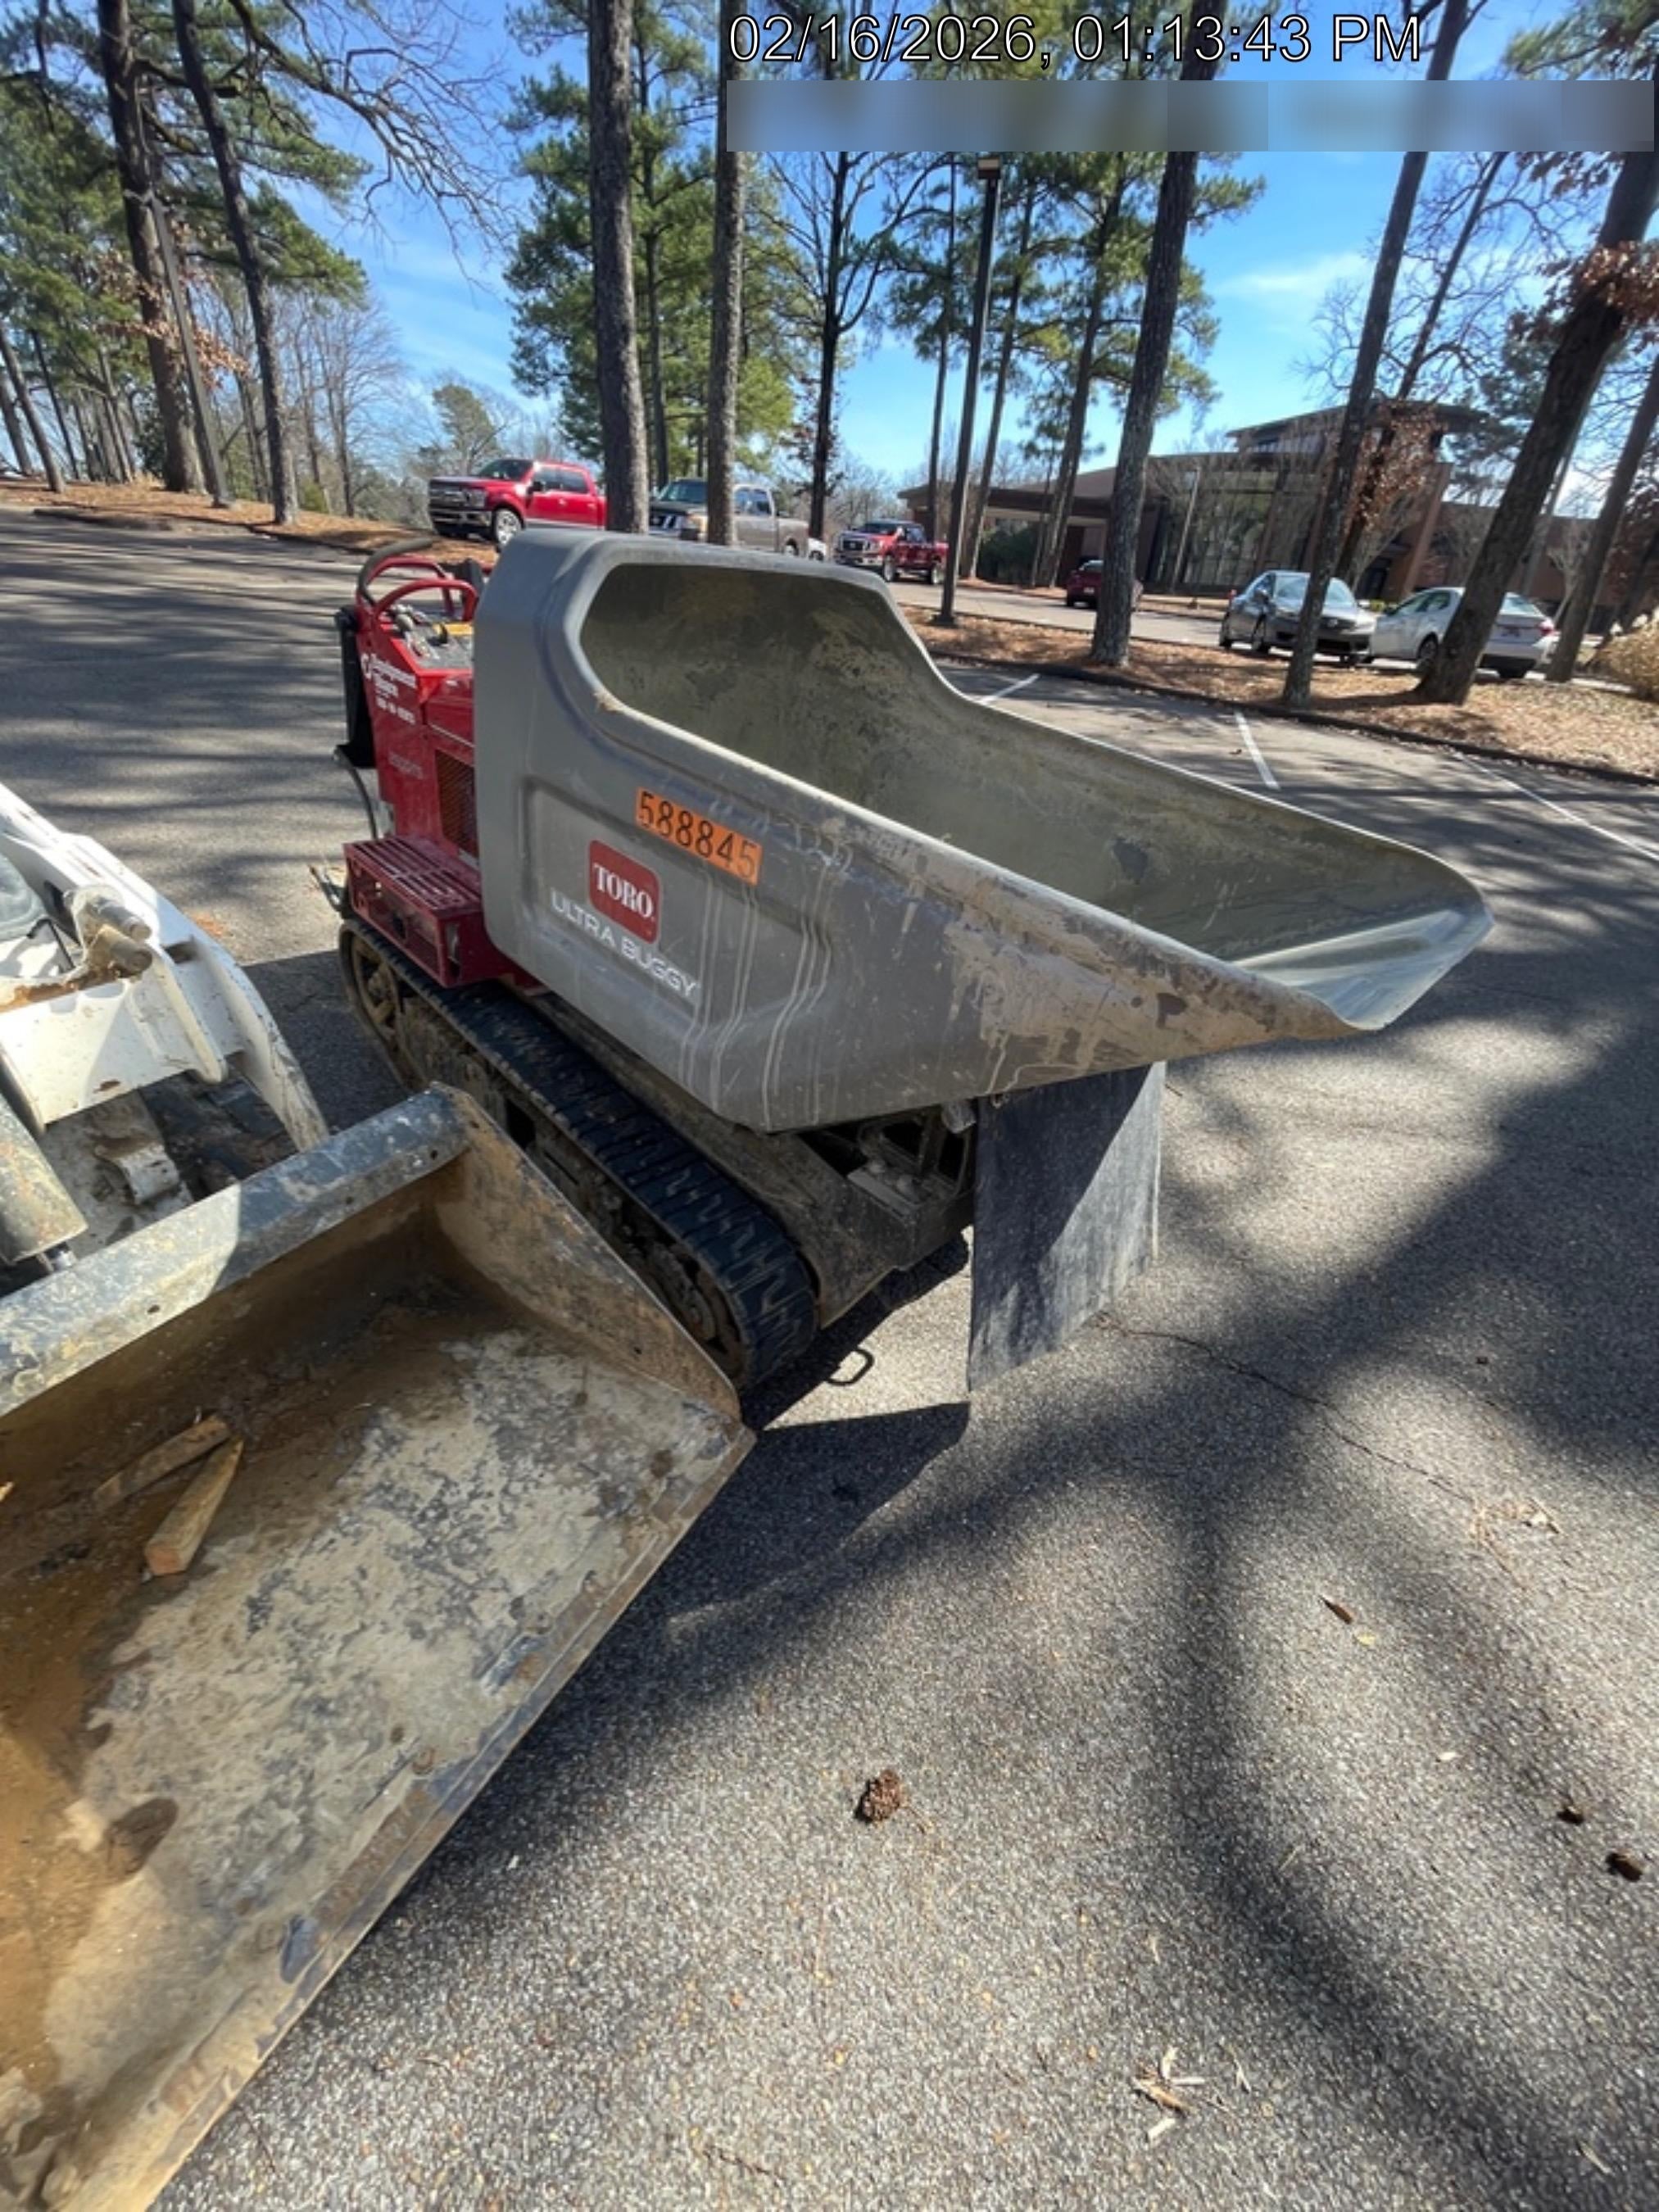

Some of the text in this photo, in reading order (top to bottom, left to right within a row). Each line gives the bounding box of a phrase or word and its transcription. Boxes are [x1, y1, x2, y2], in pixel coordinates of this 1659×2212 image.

[638, 790, 757, 878] 588845
[593, 863, 654, 918] TORO
[551, 889, 696, 996] ULTRA BUGGY
